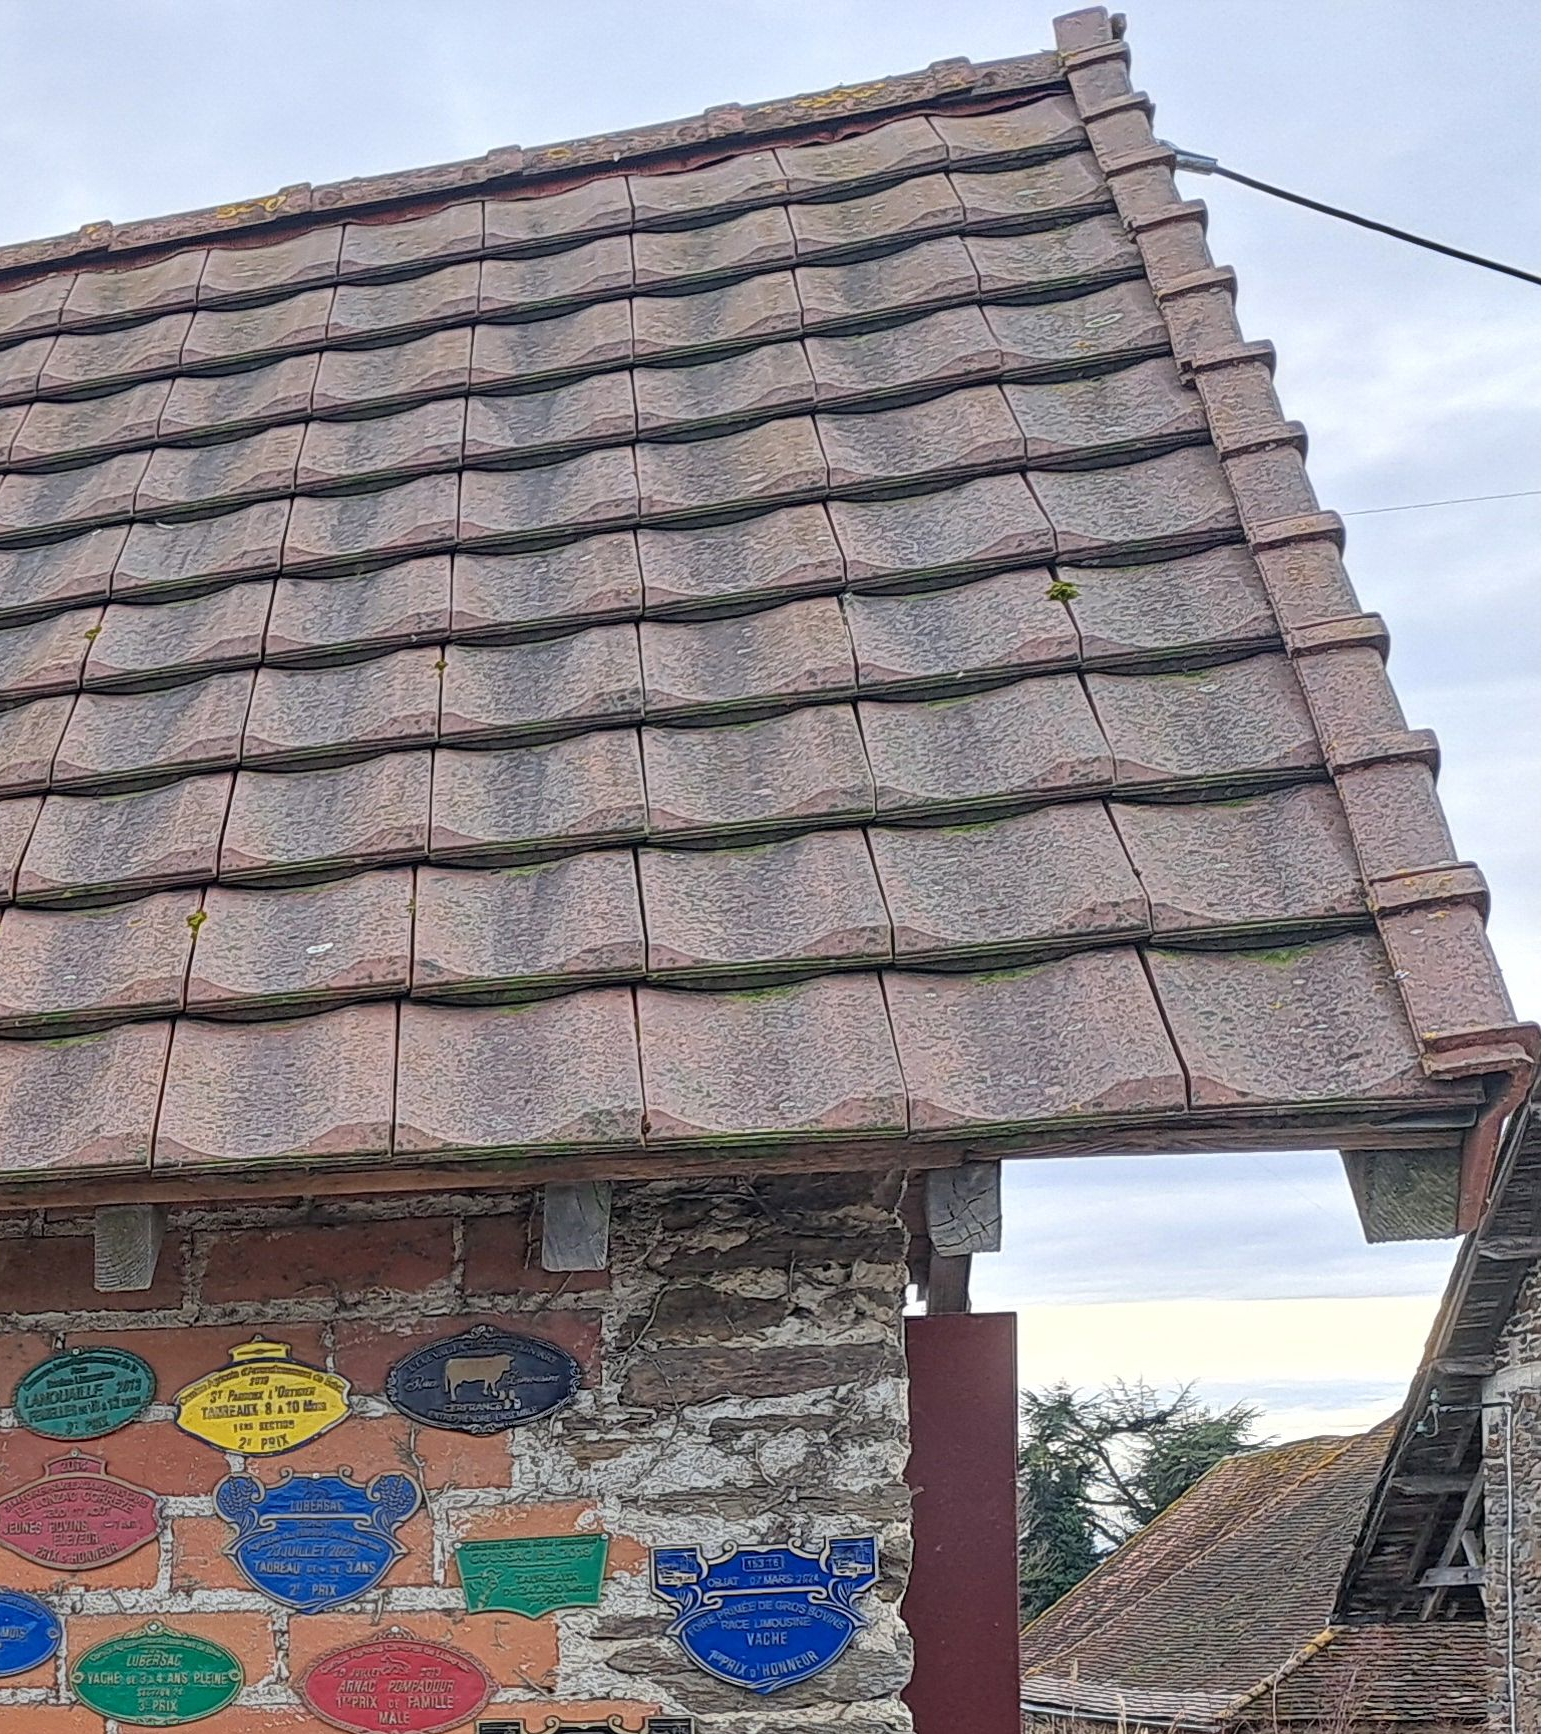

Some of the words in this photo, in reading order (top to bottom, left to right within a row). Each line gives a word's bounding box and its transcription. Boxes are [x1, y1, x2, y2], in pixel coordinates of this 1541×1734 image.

[201, 1404, 258, 1420] TAUREAUX
[265, 1404, 272, 1415] 8
[287, 1402, 299, 1413] 10
[290, 1501, 343, 1512] LUBERSAC
[3, 1522, 43, 1535] JEUNES
[281, 1545, 325, 1557] JUILLET
[254, 1563, 300, 1574] TAUREAU
[764, 1575, 793, 1584] MARS
[312, 1586, 336, 1596] PRIX
[687, 1616, 717, 1636] FOIRE
[758, 1601, 772, 1610] DE
[776, 1602, 806, 1614] GROS
[807, 1607, 846, 1629] BOVINS
[721, 1620, 749, 1630] RACE
[754, 1617, 812, 1628] LIMOUSINE
[747, 1632, 788, 1646] VACHE
[126, 1654, 183, 1667] LUBERSAC
[88, 1674, 119, 1684] VACHE
[166, 1673, 188, 1684] ANS
[194, 1673, 228, 1684] PLEINE
[338, 1681, 376, 1693] ARNAC
[387, 1680, 454, 1693] POMPADOUR
[152, 1700, 178, 1711] PRIX
[351, 1697, 377, 1708] PRIX
[407, 1697, 454, 1708] FAMILLE
[378, 1712, 409, 1724] MALE
